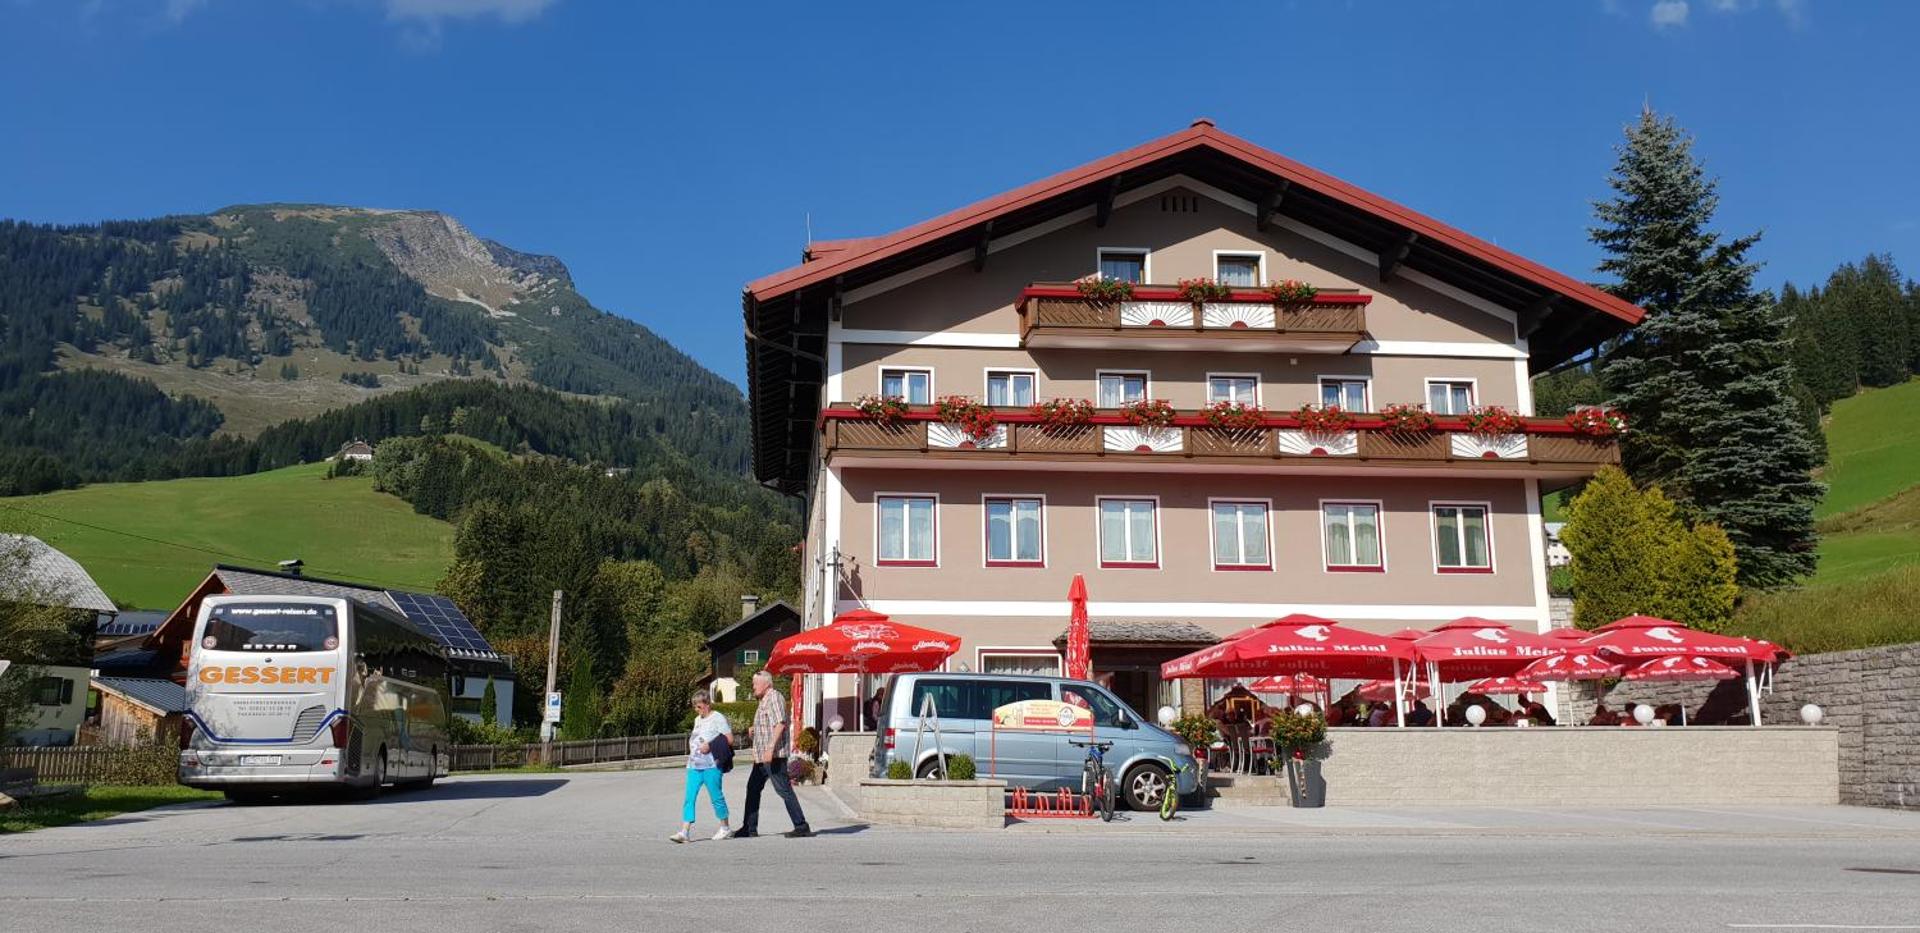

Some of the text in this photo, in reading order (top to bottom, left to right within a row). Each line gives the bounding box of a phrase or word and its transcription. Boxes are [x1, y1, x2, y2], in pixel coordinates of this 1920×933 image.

[231, 608, 317, 616] www.gessert-reisen.de
[1268, 644, 1388, 653] Julius Meinl
[1452, 646, 1507, 656] Julius
[1694, 646, 1747, 654] Meinl
[199, 666, 336, 684] GESSERT
